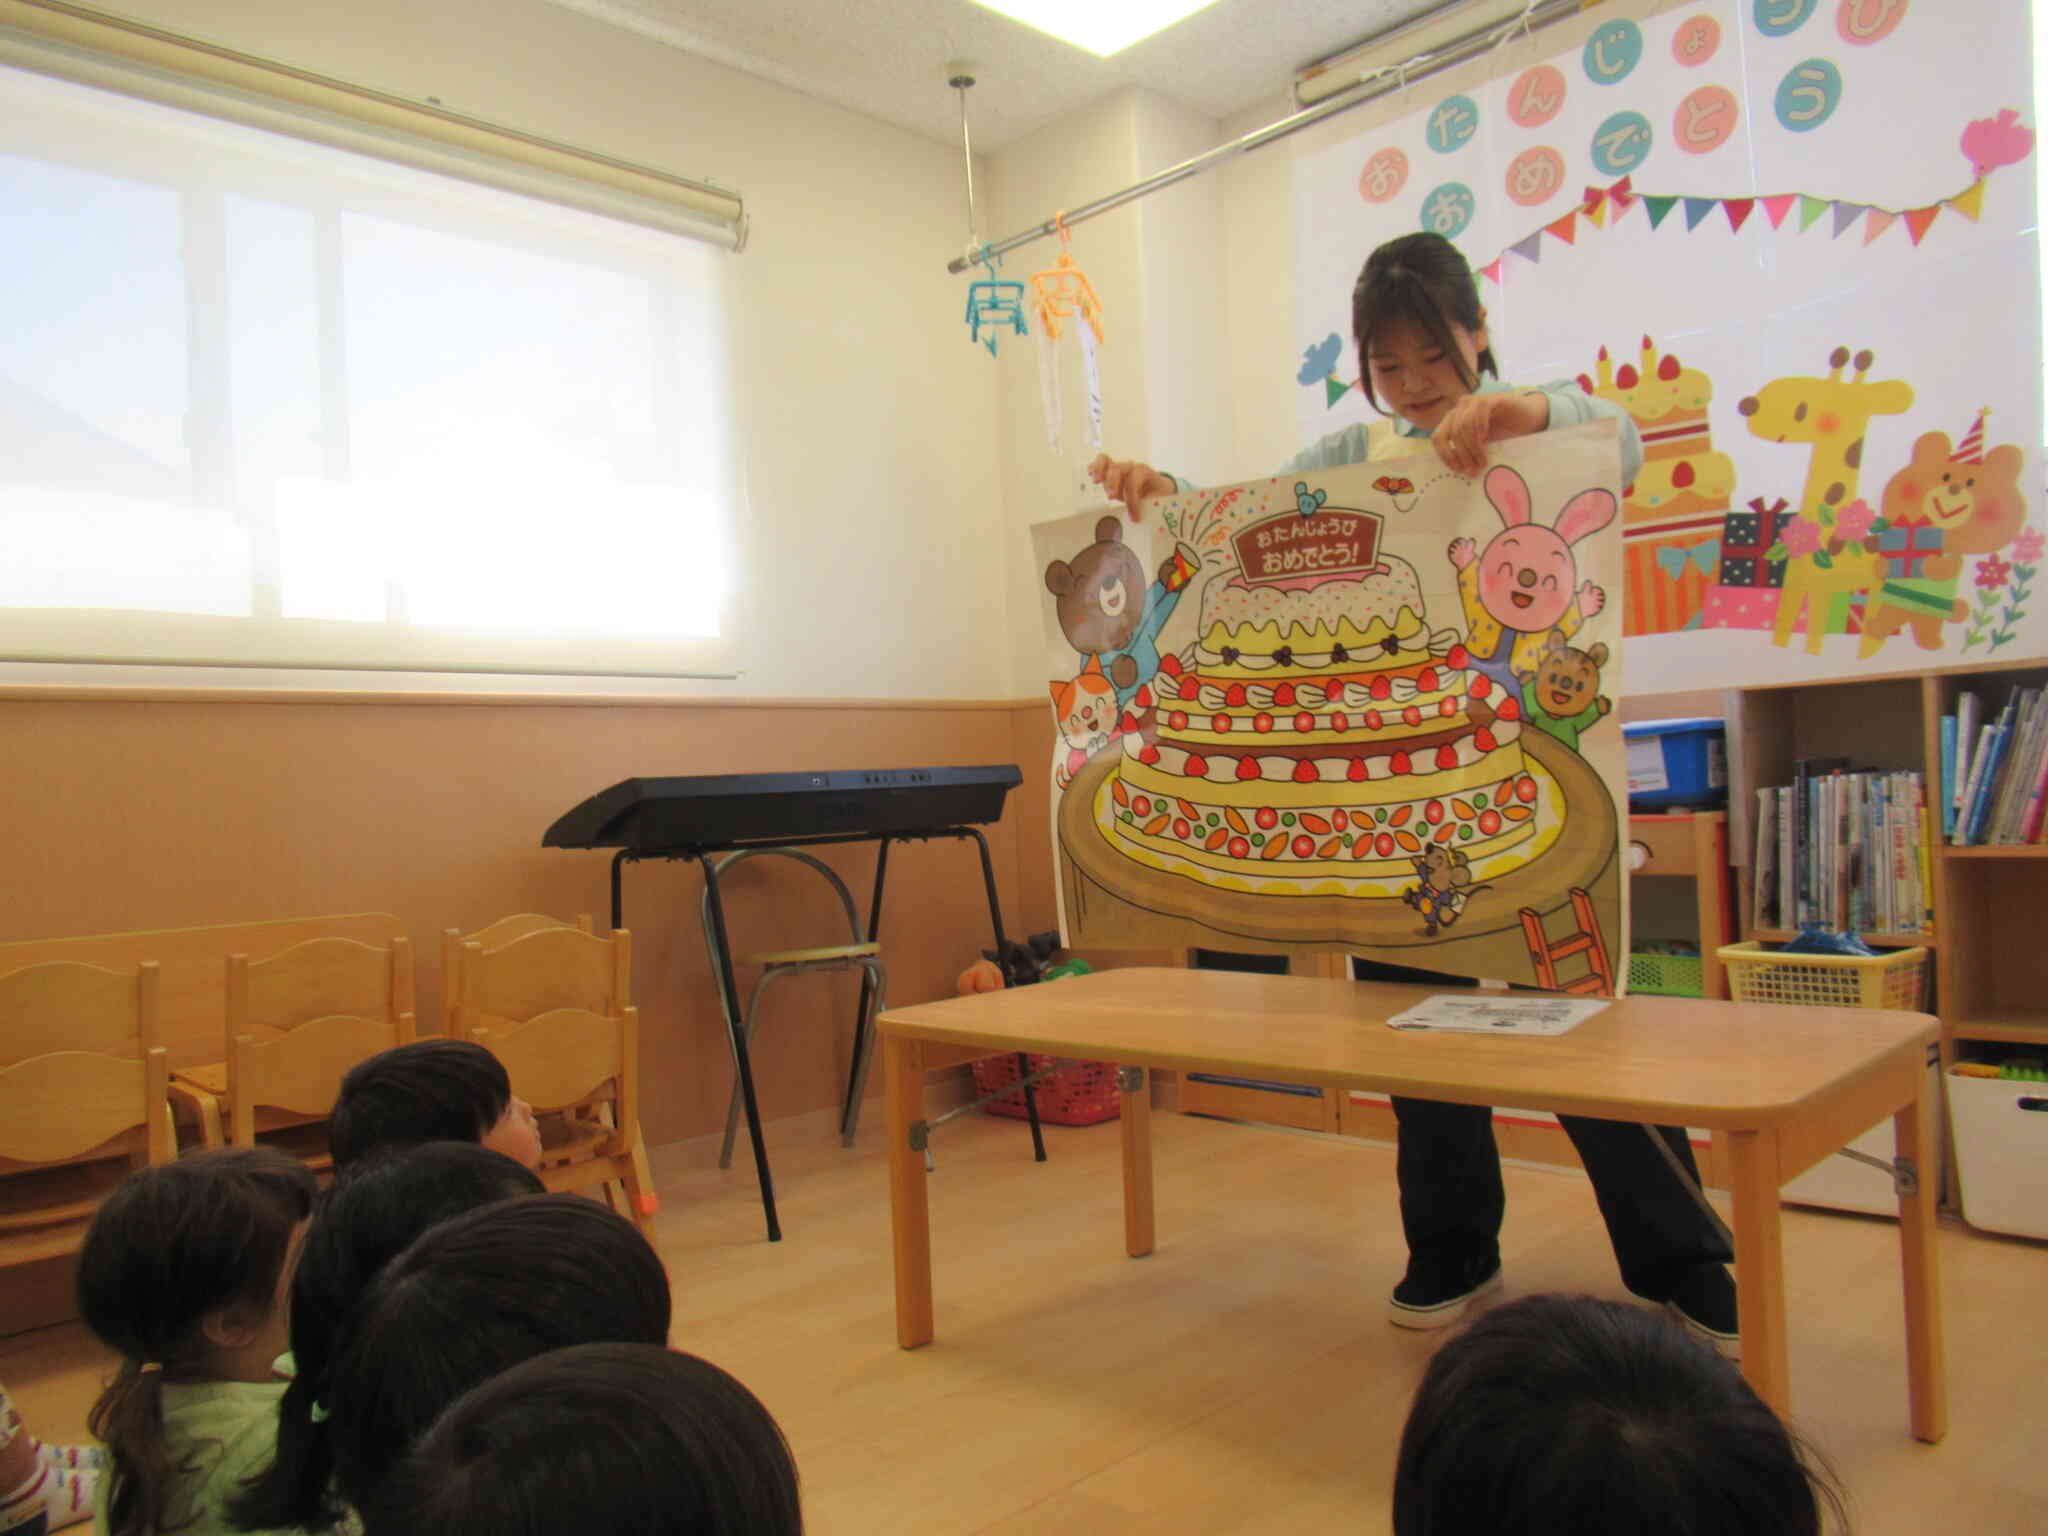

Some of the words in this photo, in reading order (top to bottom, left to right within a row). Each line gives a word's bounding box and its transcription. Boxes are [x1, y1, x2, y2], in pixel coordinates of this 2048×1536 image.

[1427, 68, 1826, 234] おめでとう
[1256, 518, 1358, 548] おたんじょうび
